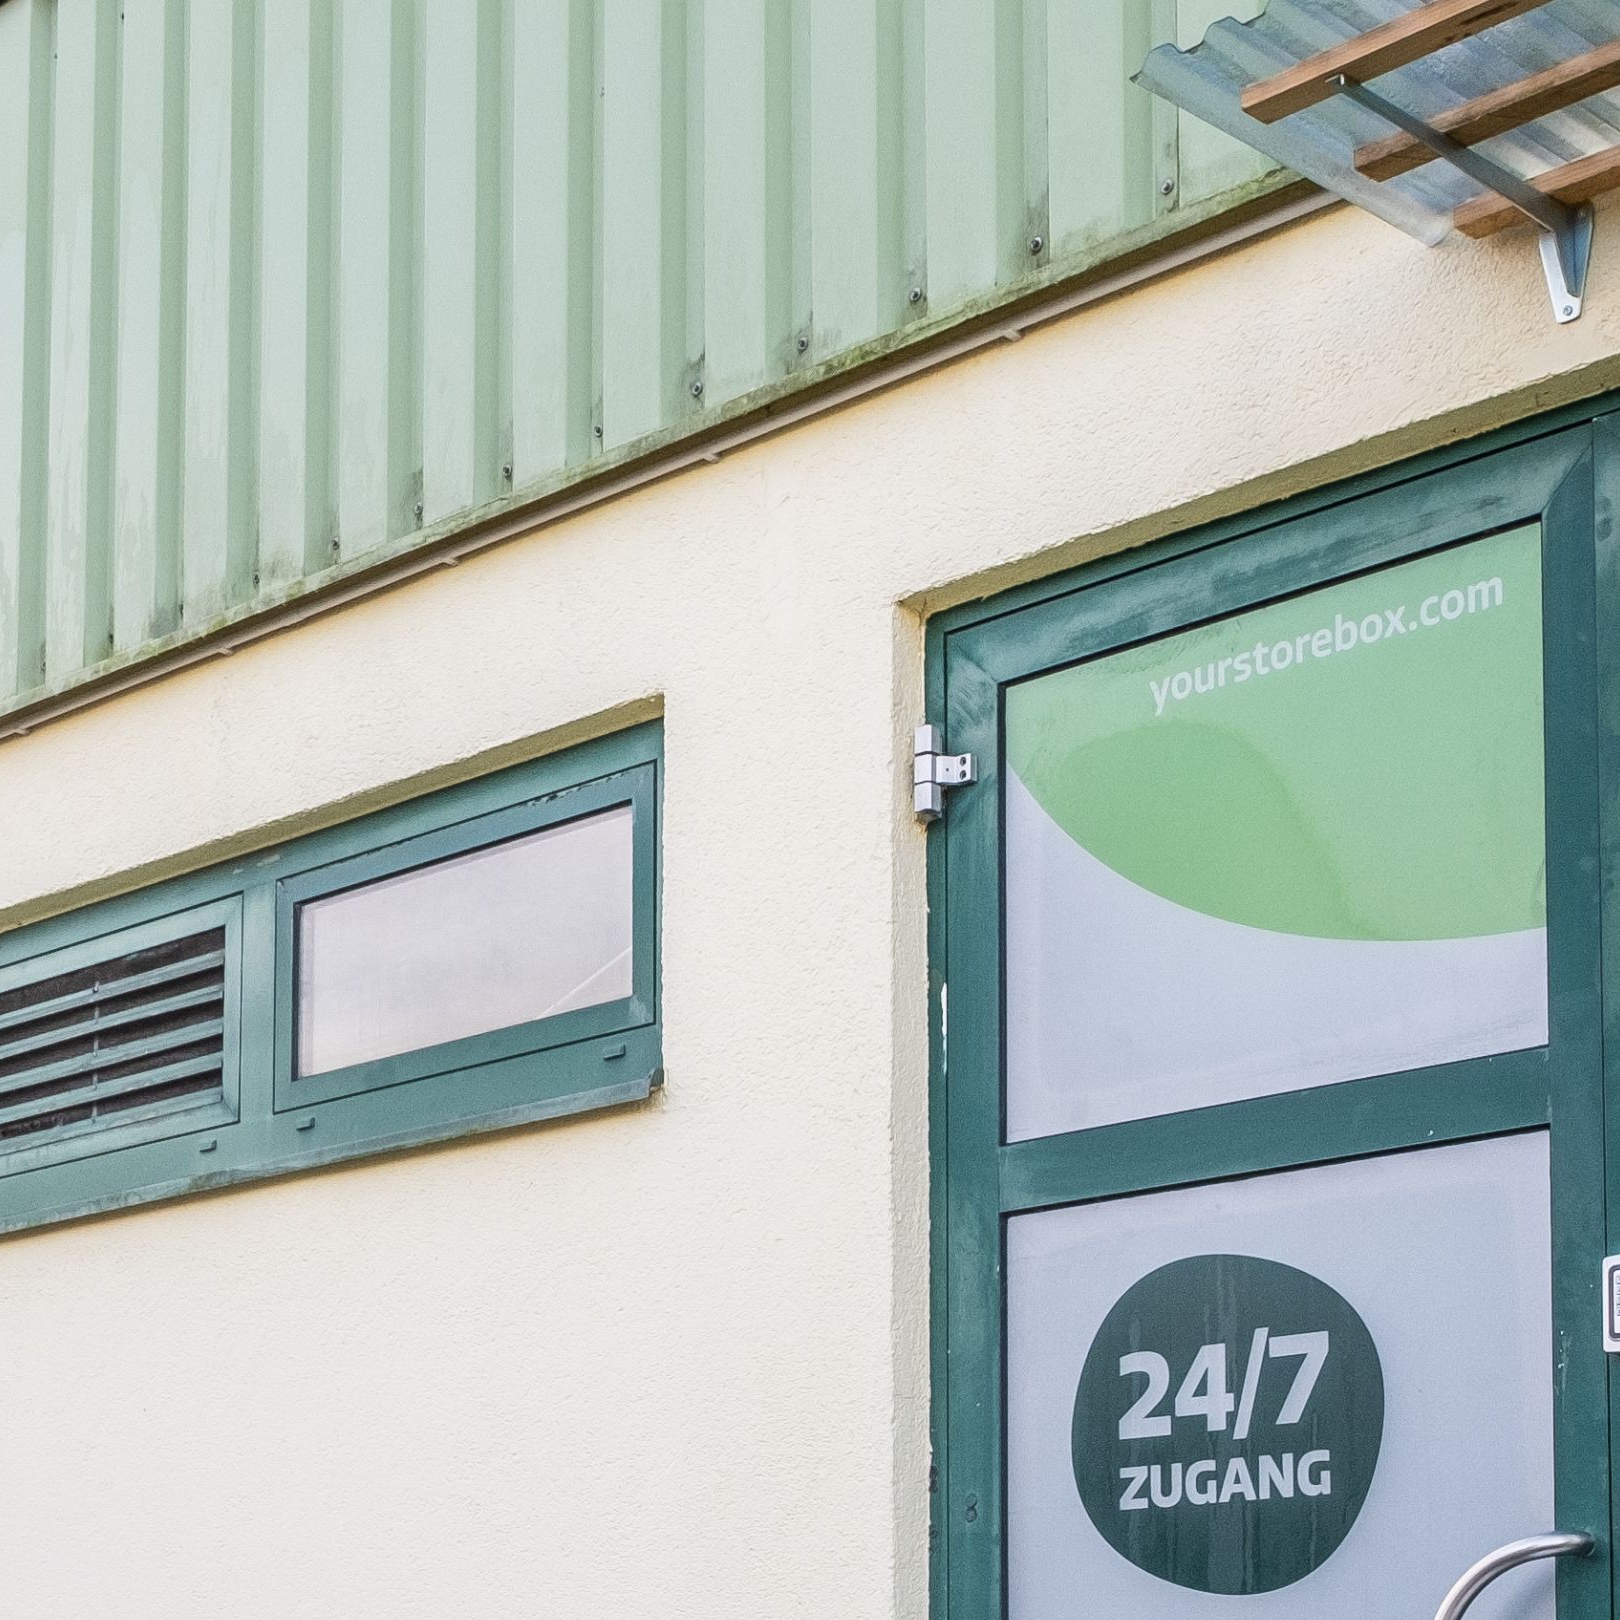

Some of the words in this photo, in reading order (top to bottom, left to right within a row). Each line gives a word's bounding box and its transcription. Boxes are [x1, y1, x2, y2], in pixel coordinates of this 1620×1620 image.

[1149, 576, 1504, 717] yourstorebox.com
[1118, 1327, 1330, 1440] 24/7
[1119, 1449, 1331, 1511] ZUGANG
